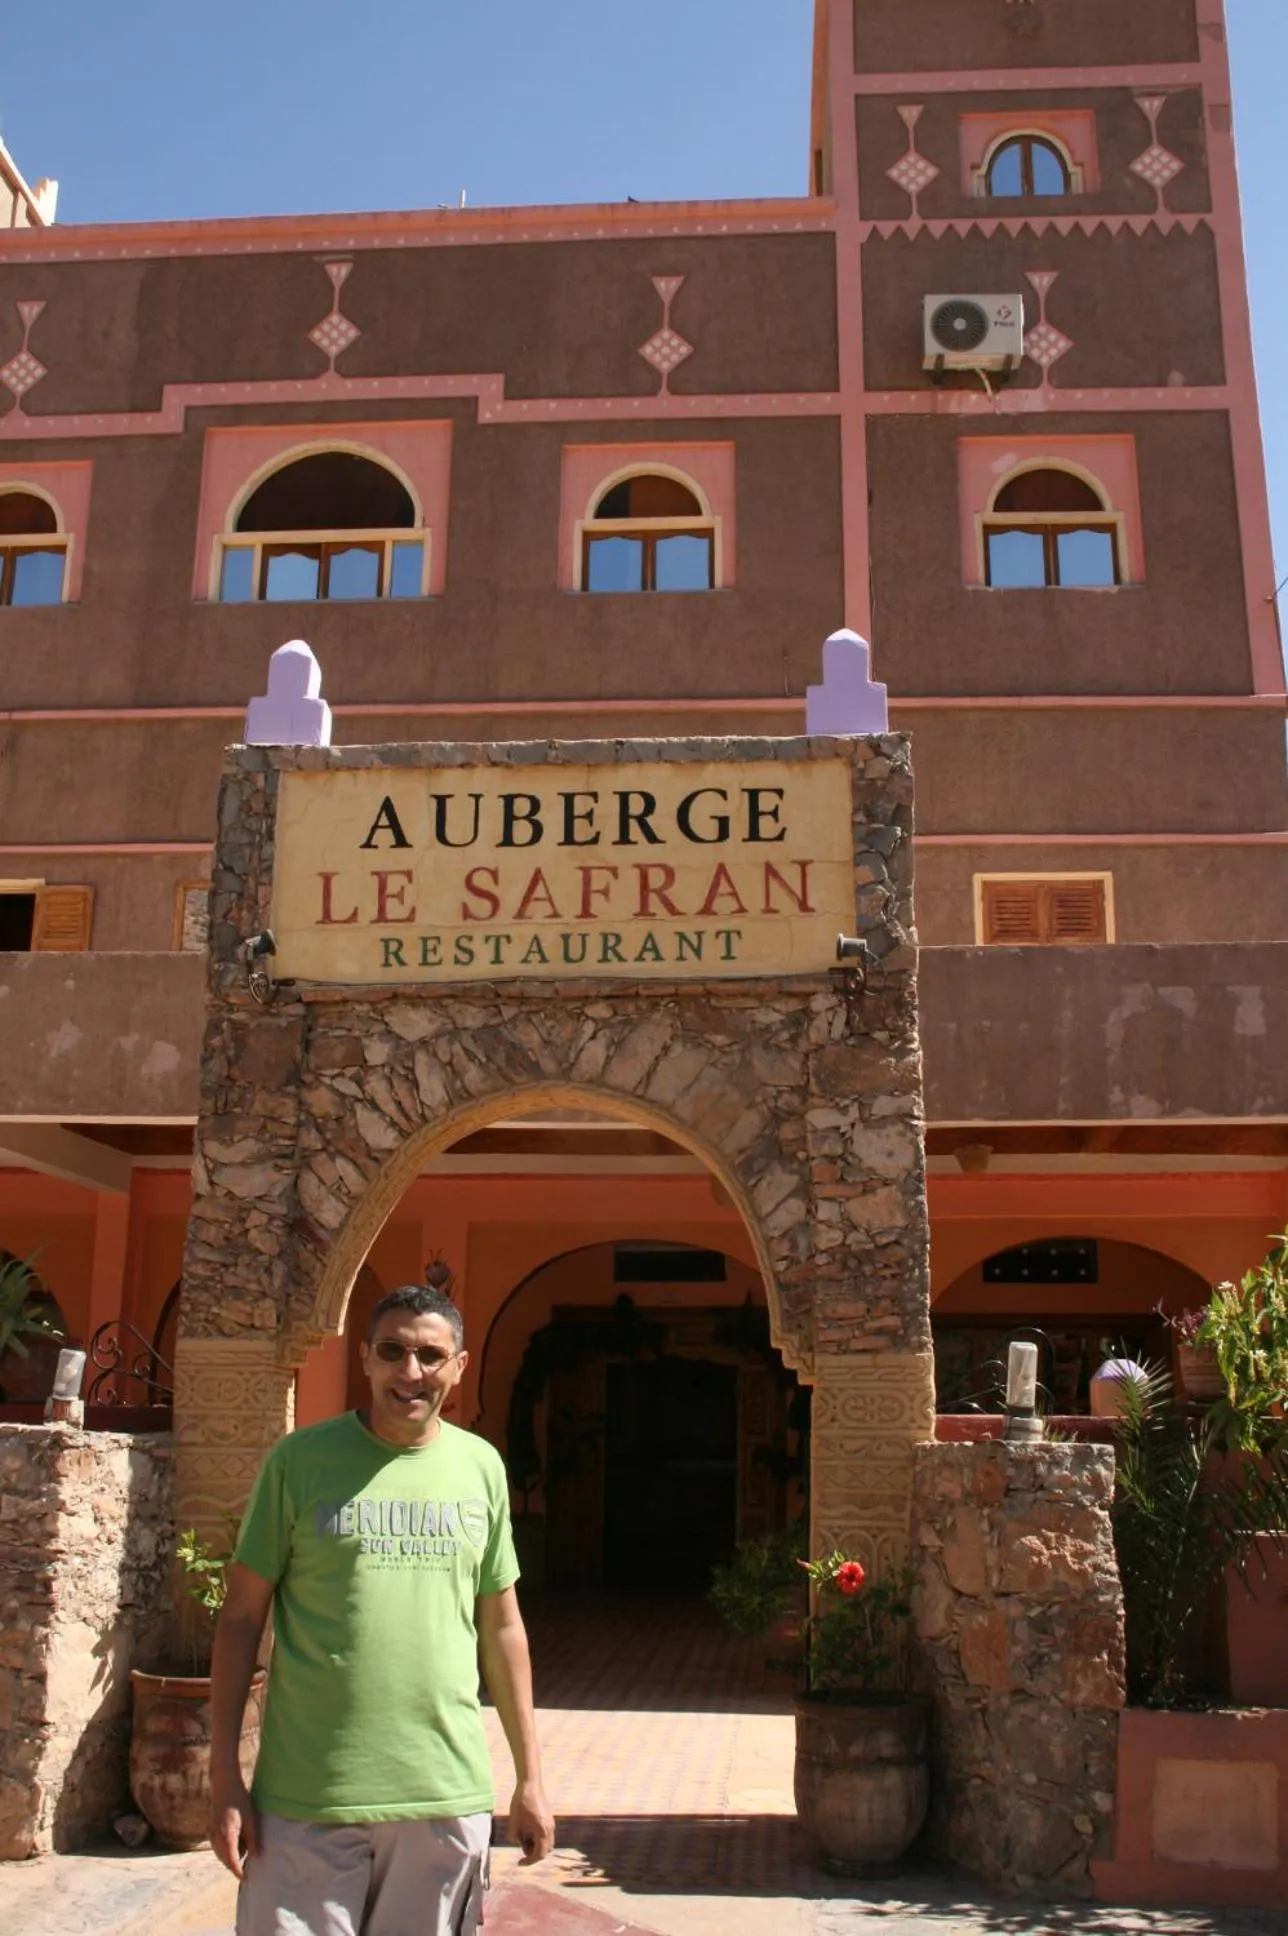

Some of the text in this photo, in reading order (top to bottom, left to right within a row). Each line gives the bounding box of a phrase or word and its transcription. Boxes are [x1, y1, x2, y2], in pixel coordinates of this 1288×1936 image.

[359, 787, 787, 850] AUBERGE
[315, 859, 817, 925] LE SAFRAN
[380, 929, 743, 968] RESTAURANT
[319, 1500, 457, 1537] MERIDIAN
